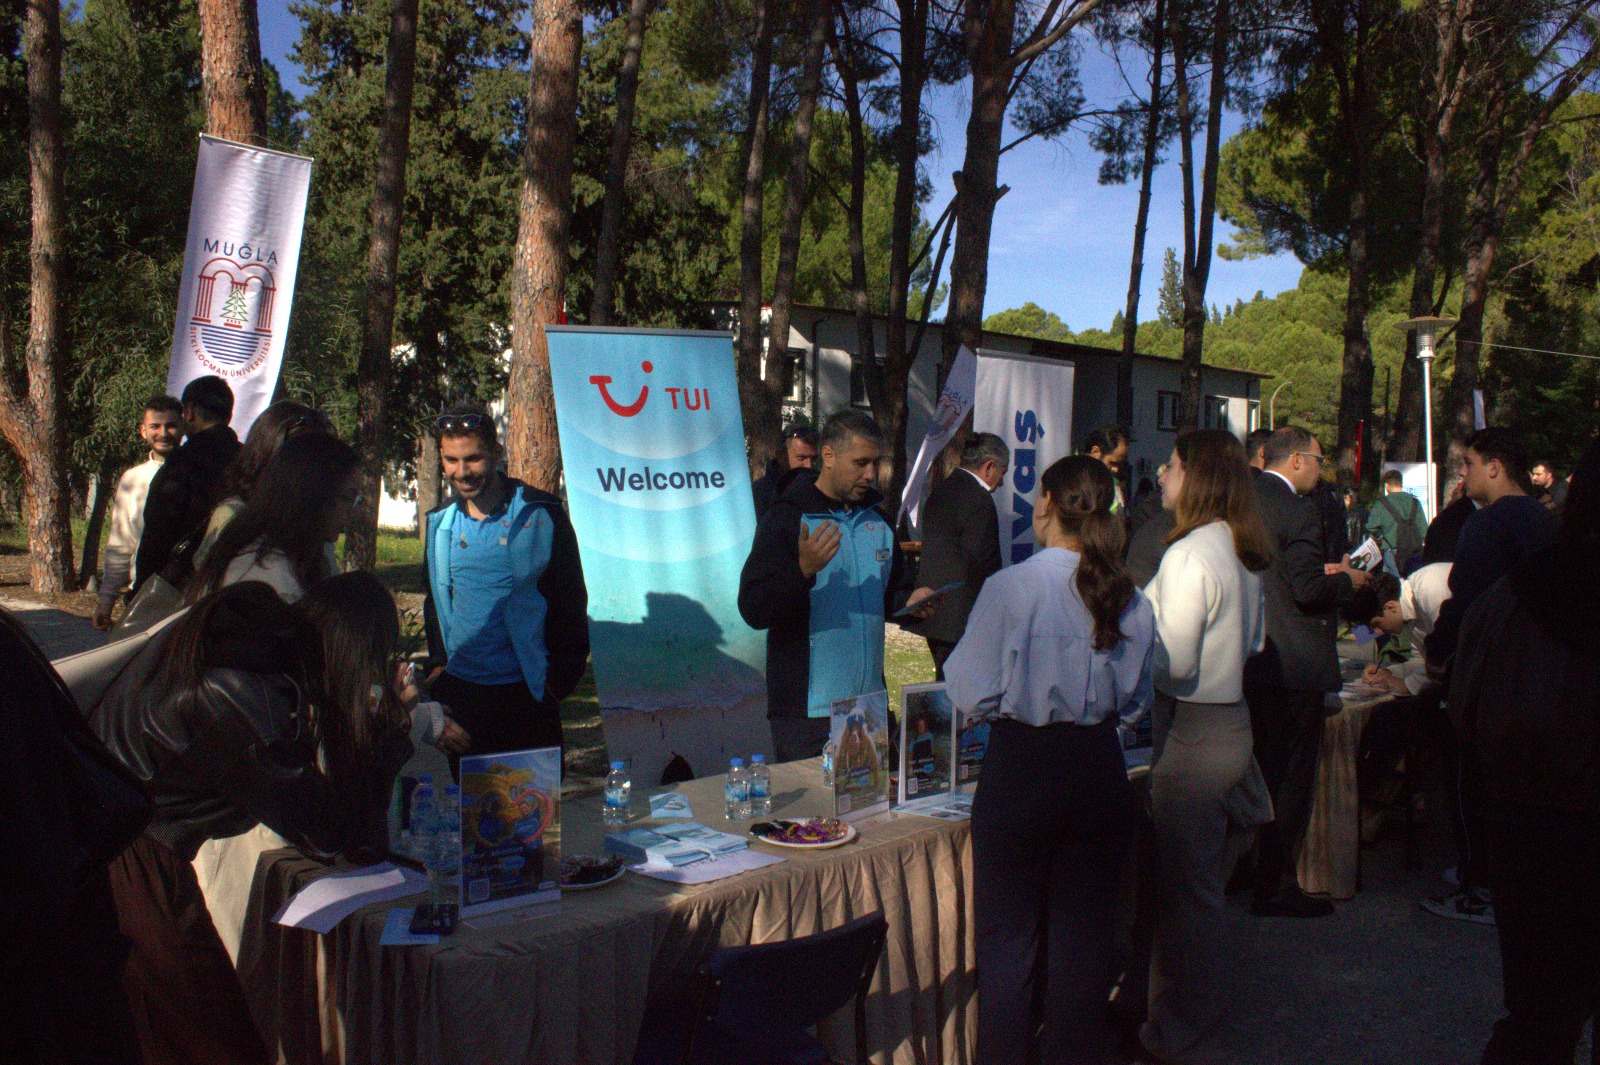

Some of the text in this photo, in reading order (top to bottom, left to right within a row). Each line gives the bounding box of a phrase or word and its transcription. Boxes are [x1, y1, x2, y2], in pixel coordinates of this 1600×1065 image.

[203, 238, 278, 264] MUĞLA
[194, 348, 228, 376] KOÇMAN
[665, 387, 710, 410] TUI
[596, 467, 725, 492] Welcome
